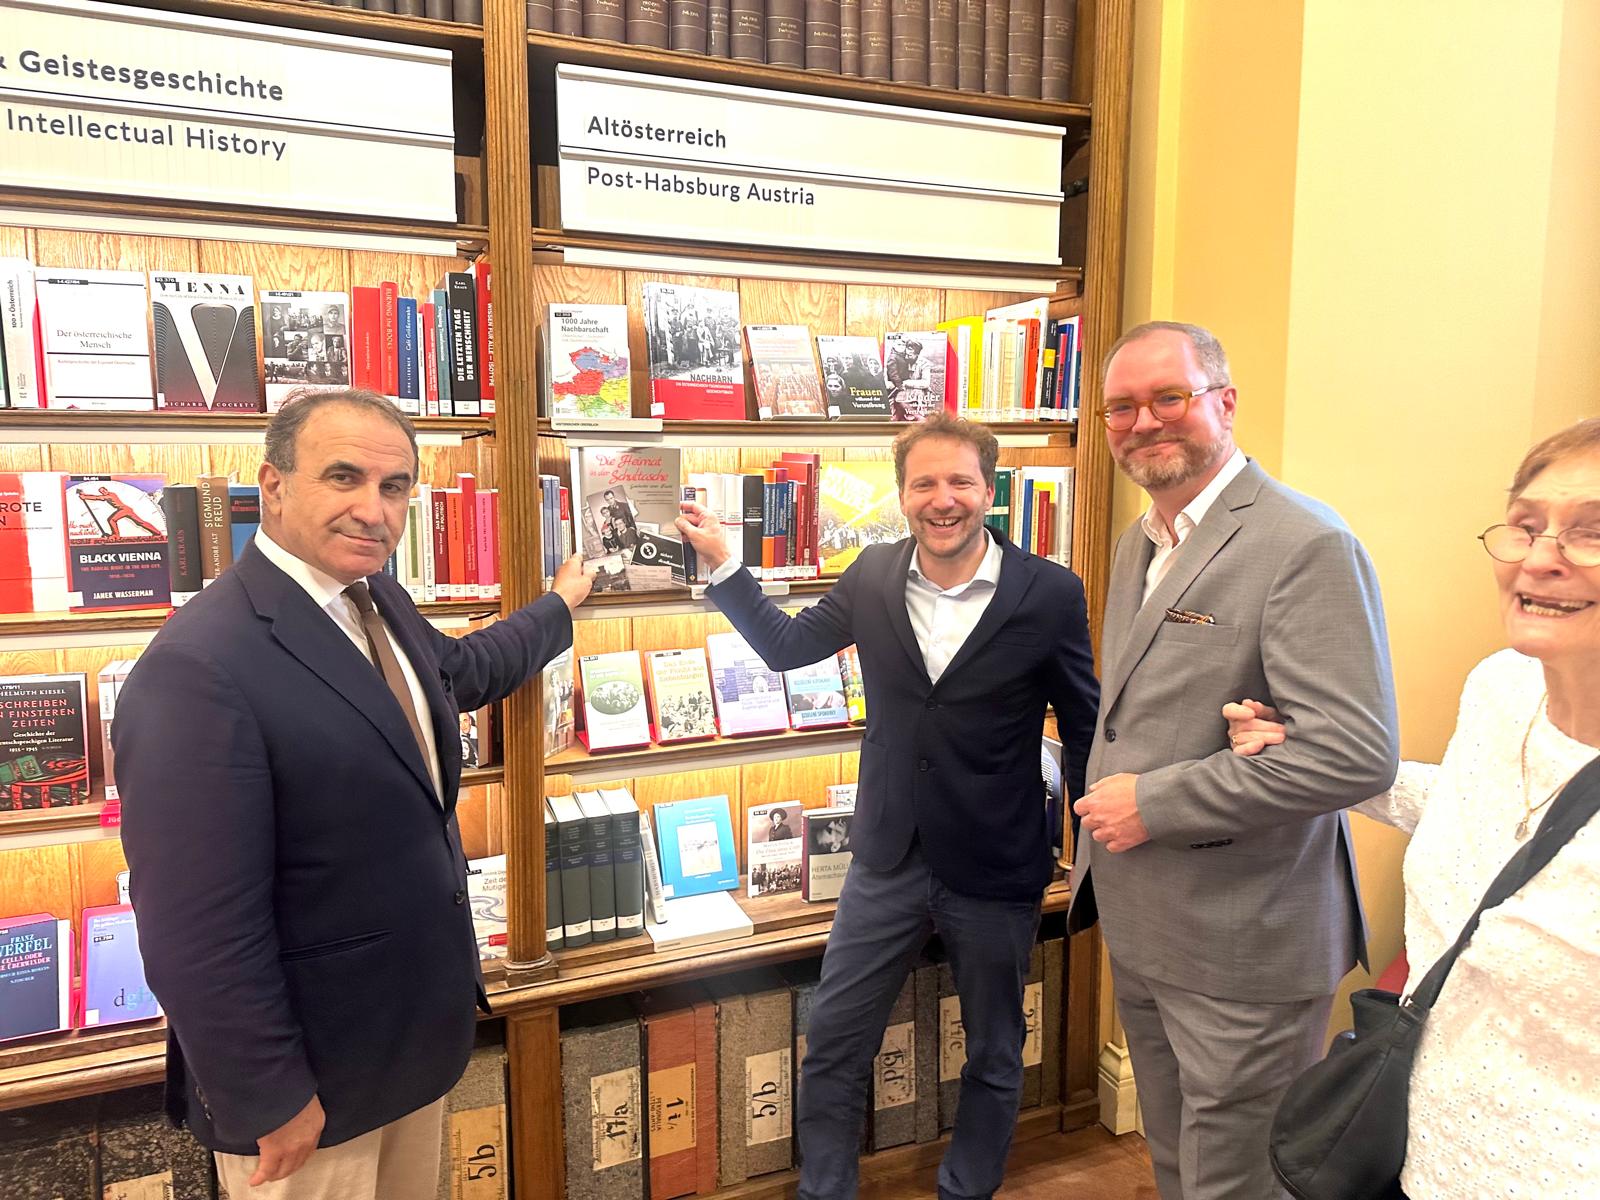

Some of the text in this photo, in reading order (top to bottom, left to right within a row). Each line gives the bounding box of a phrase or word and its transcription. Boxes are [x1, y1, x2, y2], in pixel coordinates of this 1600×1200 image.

[19, 50, 283, 101] Geistesgeschichte
[7, 109, 287, 161] Intellectual History
[588, 116, 726, 149] Altösterreich
[588, 167, 815, 206] Post-Habsburg Austria
[159, 282, 246, 296] VIENNA
[561, 318, 598, 326] 1000 Jahre
[57, 329, 71, 338] Der
[561, 326, 609, 334] Nachbarschaft
[453, 308, 465, 381] DIE LETZTEN TAGE
[463, 310, 474, 380] DER MENSCHHEIT
[690, 374, 733, 384] NACHBARN
[850, 387, 883, 396] Frauen
[202, 482, 213, 528] SIGMUND
[213, 496, 223, 528] FREUD
[79, 551, 162, 564] BLACK VIENNA
[93, 589, 154, 600] JANEK WASSERMAN
[0, 699, 67, 709] SCHREIBEN
[9, 708, 75, 718] FINSTEREN
[12, 719, 56, 728] ZEITEN
[812, 864, 832, 873] HERTA
[484, 877, 498, 885] Zeit
[482, 884, 507, 892] Mutige
[752, 1081, 778, 1120] 5/b
[467, 1144, 497, 1181] 5/b
